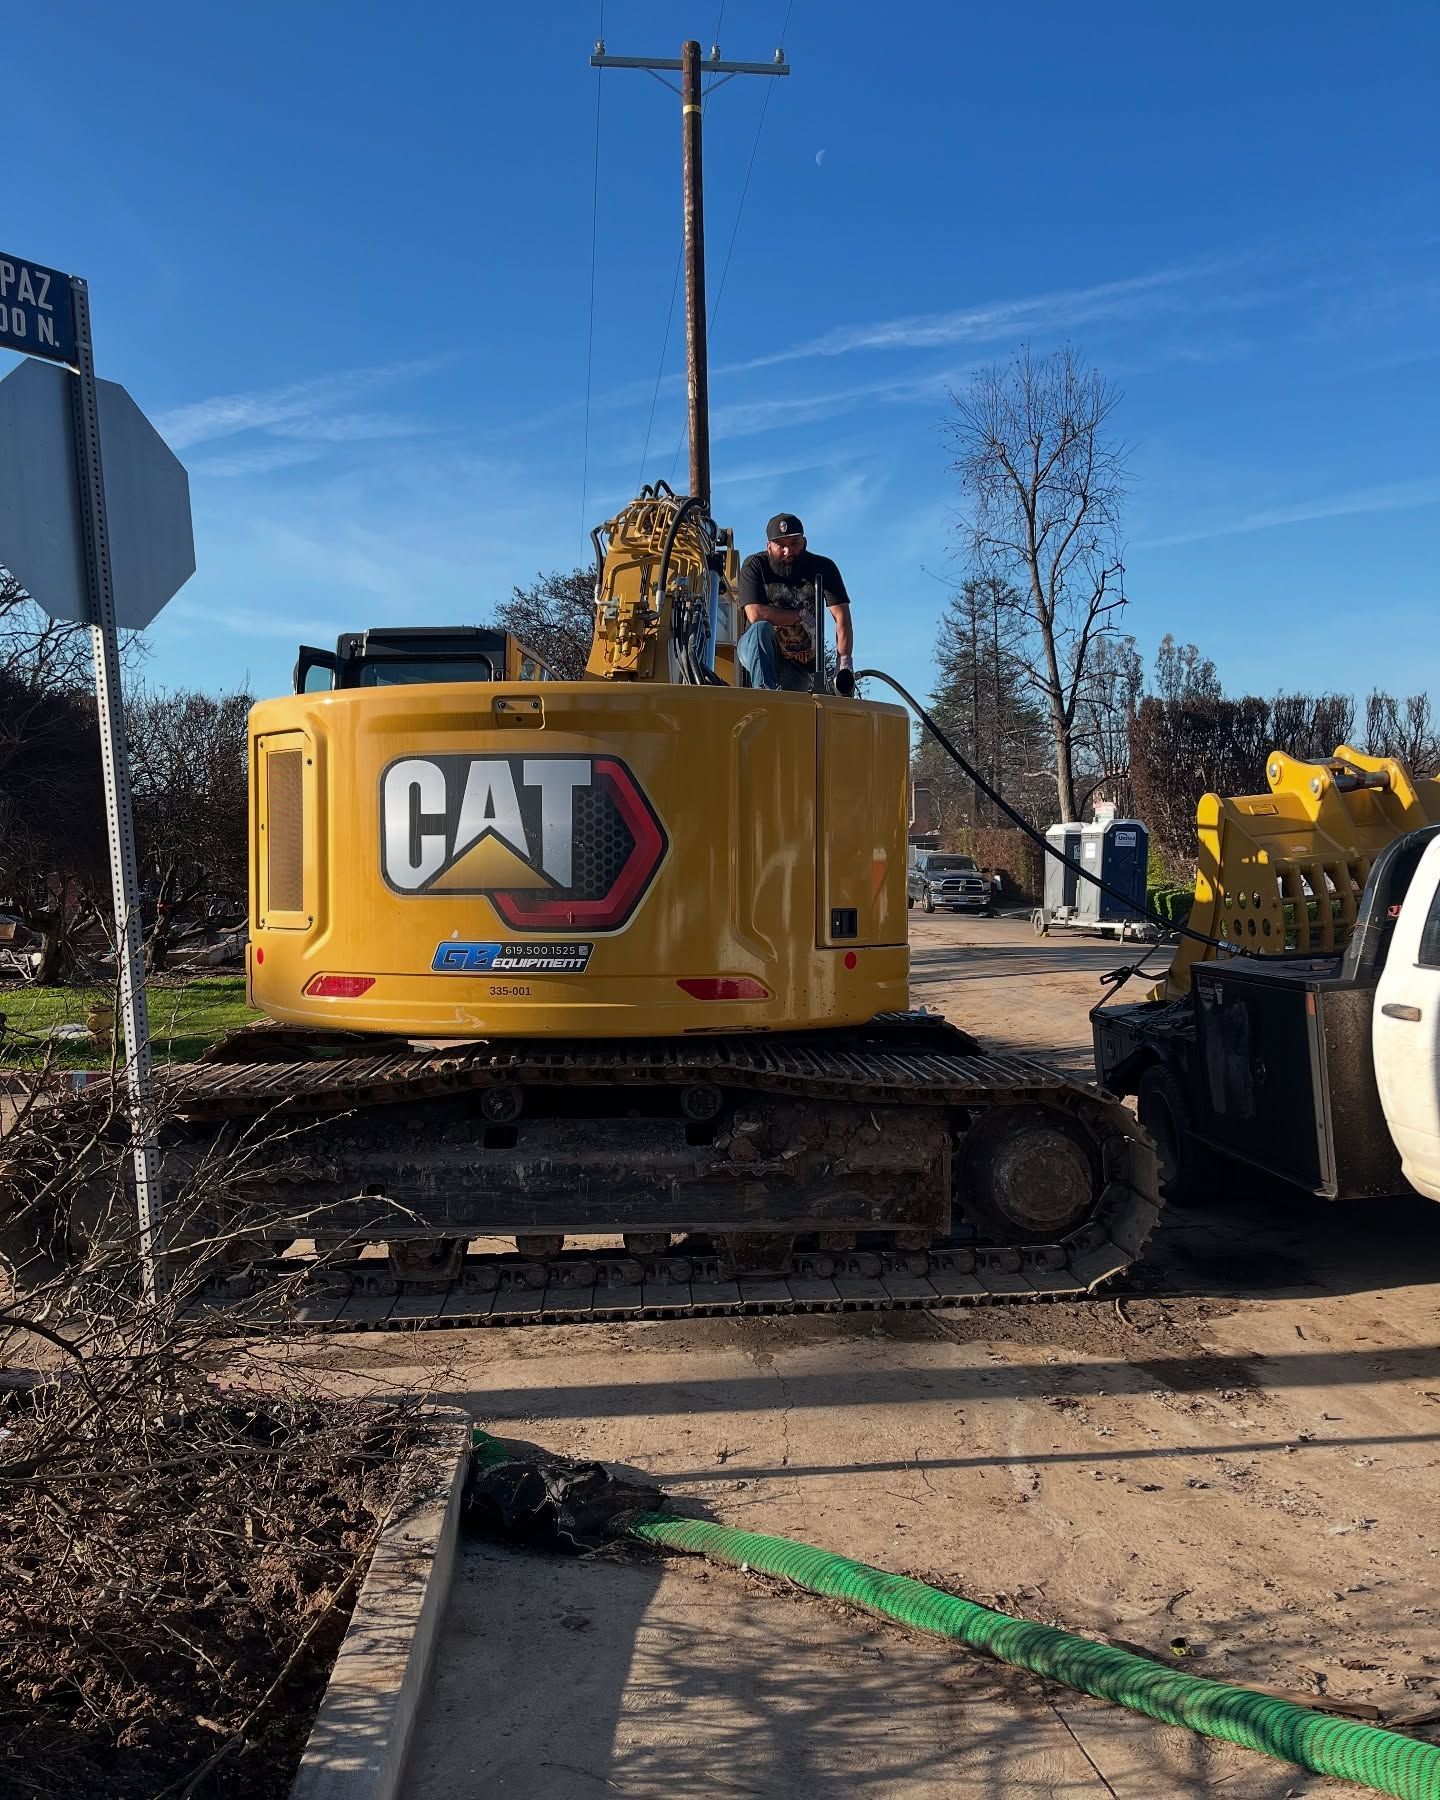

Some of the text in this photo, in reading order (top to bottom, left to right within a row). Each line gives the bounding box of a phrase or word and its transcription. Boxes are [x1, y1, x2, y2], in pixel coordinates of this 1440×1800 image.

[0, 260, 53, 311] PAZ
[38, 313, 60, 348] N.
[385, 759, 592, 889] CAT
[433, 943, 586, 970] GB EQUIPMENT
[505, 946, 576, 955] 619.500.1525
[489, 986, 532, 996] 335-001
